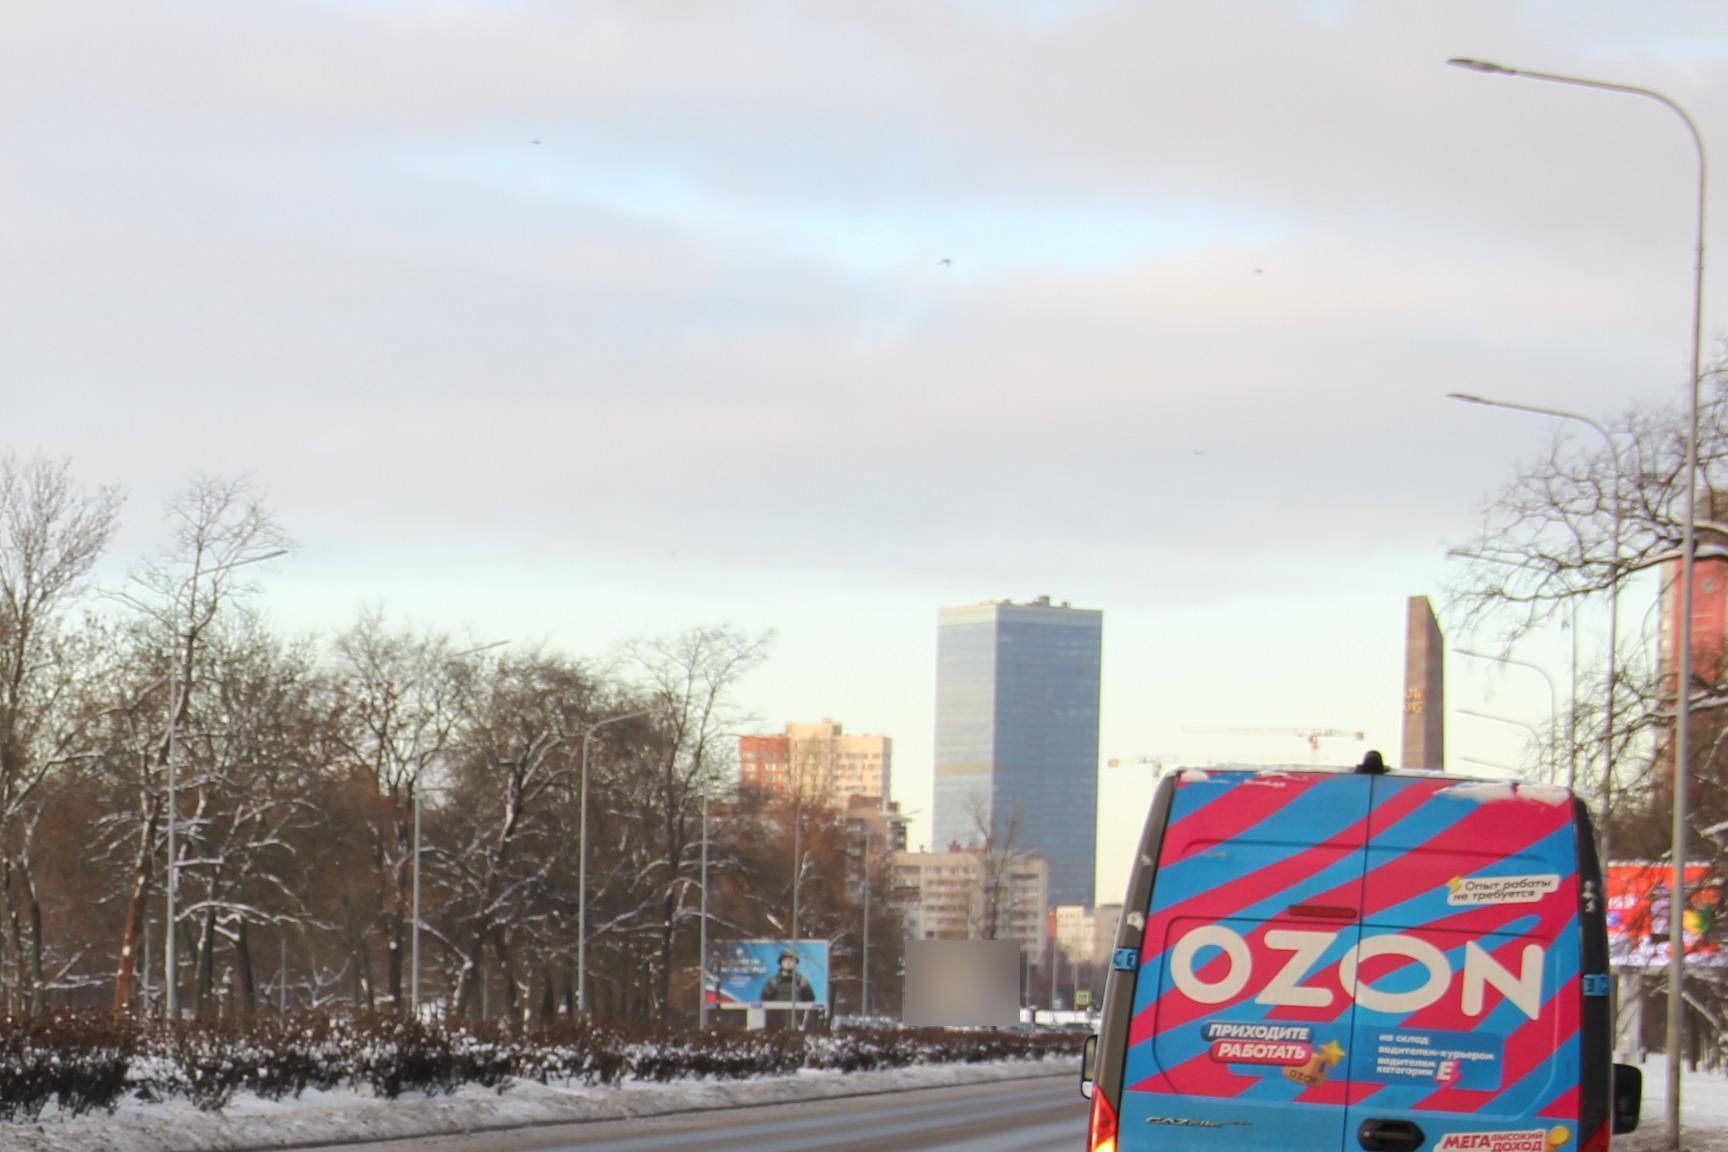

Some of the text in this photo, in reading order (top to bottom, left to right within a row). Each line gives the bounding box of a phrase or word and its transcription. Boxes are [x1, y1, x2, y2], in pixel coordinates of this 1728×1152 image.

[1464, 878, 1552, 892] Опыт работы
[1452, 890, 1535, 902] не требуется
[1170, 925, 1545, 1021] OZON
[1208, 1023, 1311, 1041] ПРИХОДИТЕ
[1378, 1033, 1430, 1046] на склад
[1217, 1043, 1307, 1060] РАБОТАТЬ
[1377, 1056, 1437, 1068] водителем
[1442, 1131, 1545, 1150] МЕГА ВЫСОКИЙ
